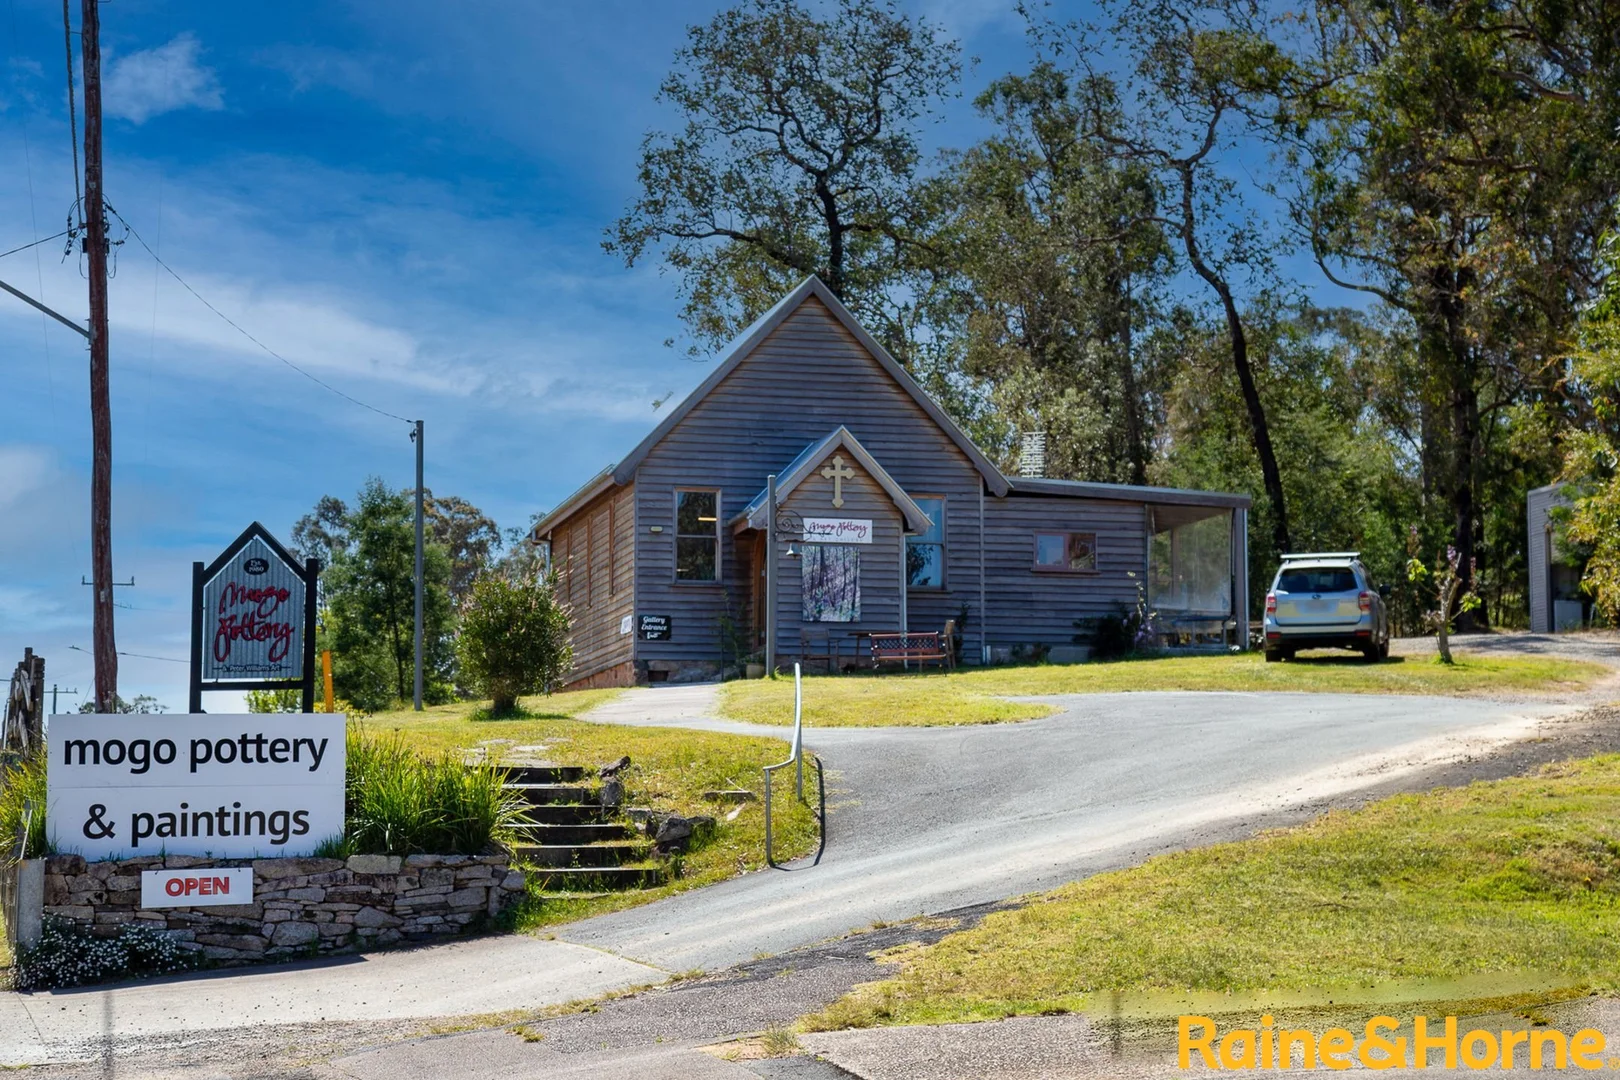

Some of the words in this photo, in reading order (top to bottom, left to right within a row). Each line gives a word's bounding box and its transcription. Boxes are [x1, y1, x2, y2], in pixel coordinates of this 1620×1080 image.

[218, 581, 291, 619] Mogo
[213, 611, 296, 663] Pottery
[643, 616, 666, 624] Gallery
[64, 738, 177, 774] mogo
[190, 733, 329, 773] pottery
[82, 803, 116, 840] &
[131, 801, 310, 848] paintings
[165, 876, 230, 897] OPEN
